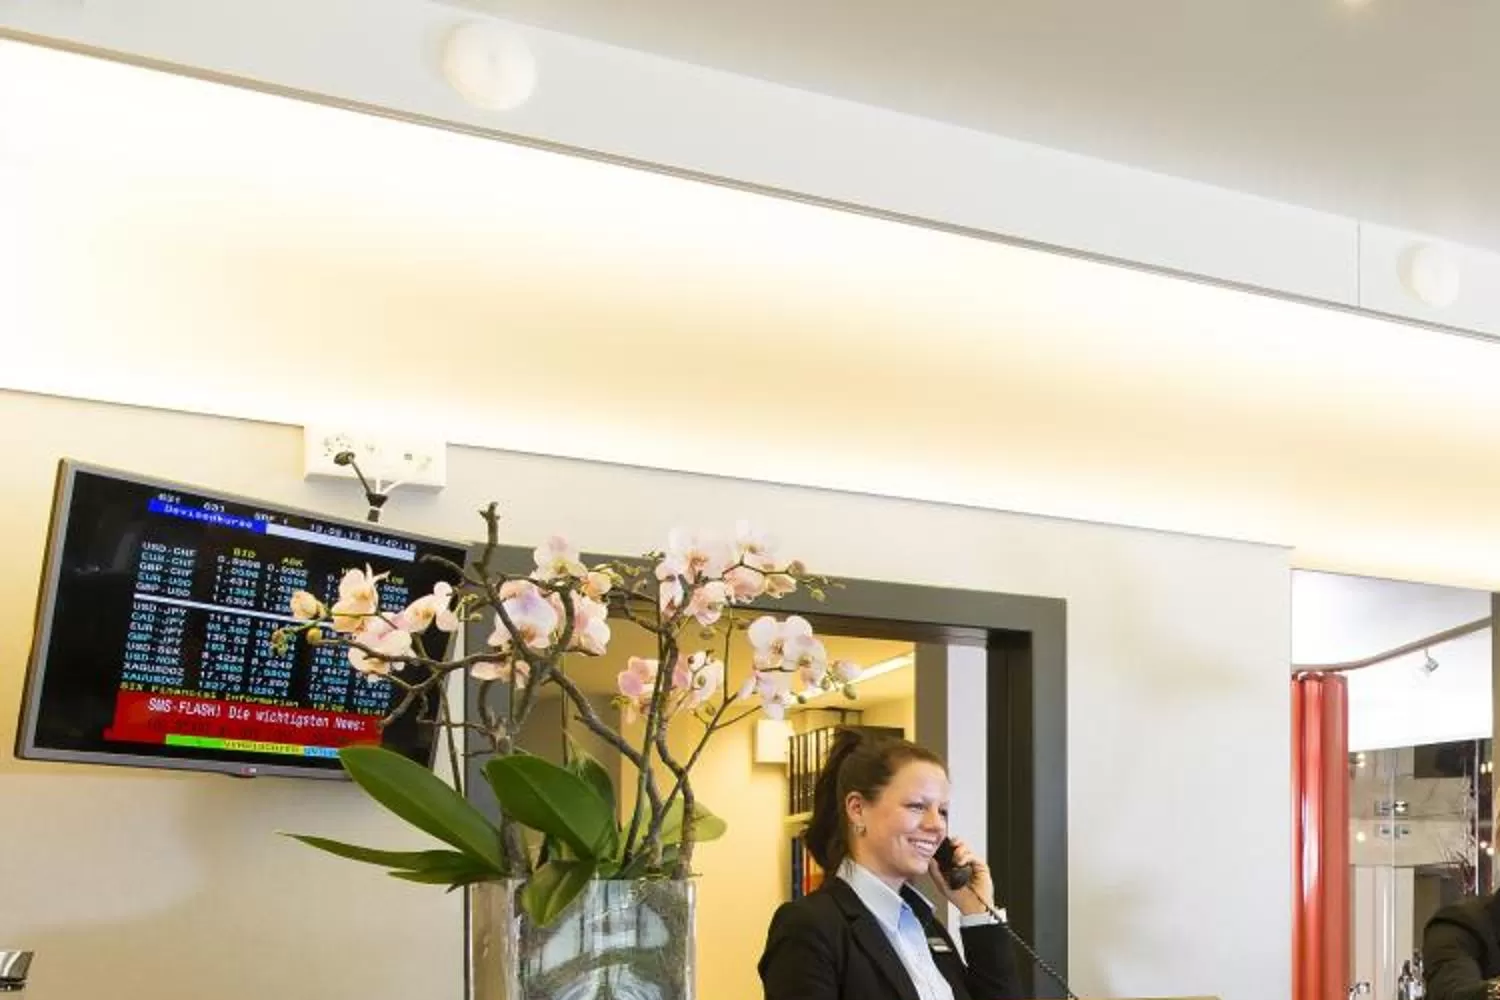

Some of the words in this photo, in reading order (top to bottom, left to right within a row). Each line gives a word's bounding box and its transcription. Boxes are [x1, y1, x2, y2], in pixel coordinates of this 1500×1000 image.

[164, 504, 253, 527] Devisenkurse
[141, 541, 197, 557] USD-CHF
[232, 547, 256, 558] BID
[140, 552, 195, 567] EUR-CHF
[139, 562, 192, 577] GBP-CHF
[137, 571, 192, 587] EUR-USD
[135, 582, 191, 597] GBP-USD
[132, 602, 186, 616] USD-JPY
[131, 611, 185, 626] CAD-JPY
[129, 621, 183, 636] EUR-JPY
[127, 632, 182, 646] GBP-JPY
[124, 651, 179, 665] USD-NOK
[151, 684, 217, 698] Financial
[225, 693, 298, 707] Information
[227, 705, 251, 719] Die
[254, 708, 329, 730] wichtigsten
[334, 718, 366, 731] News:
